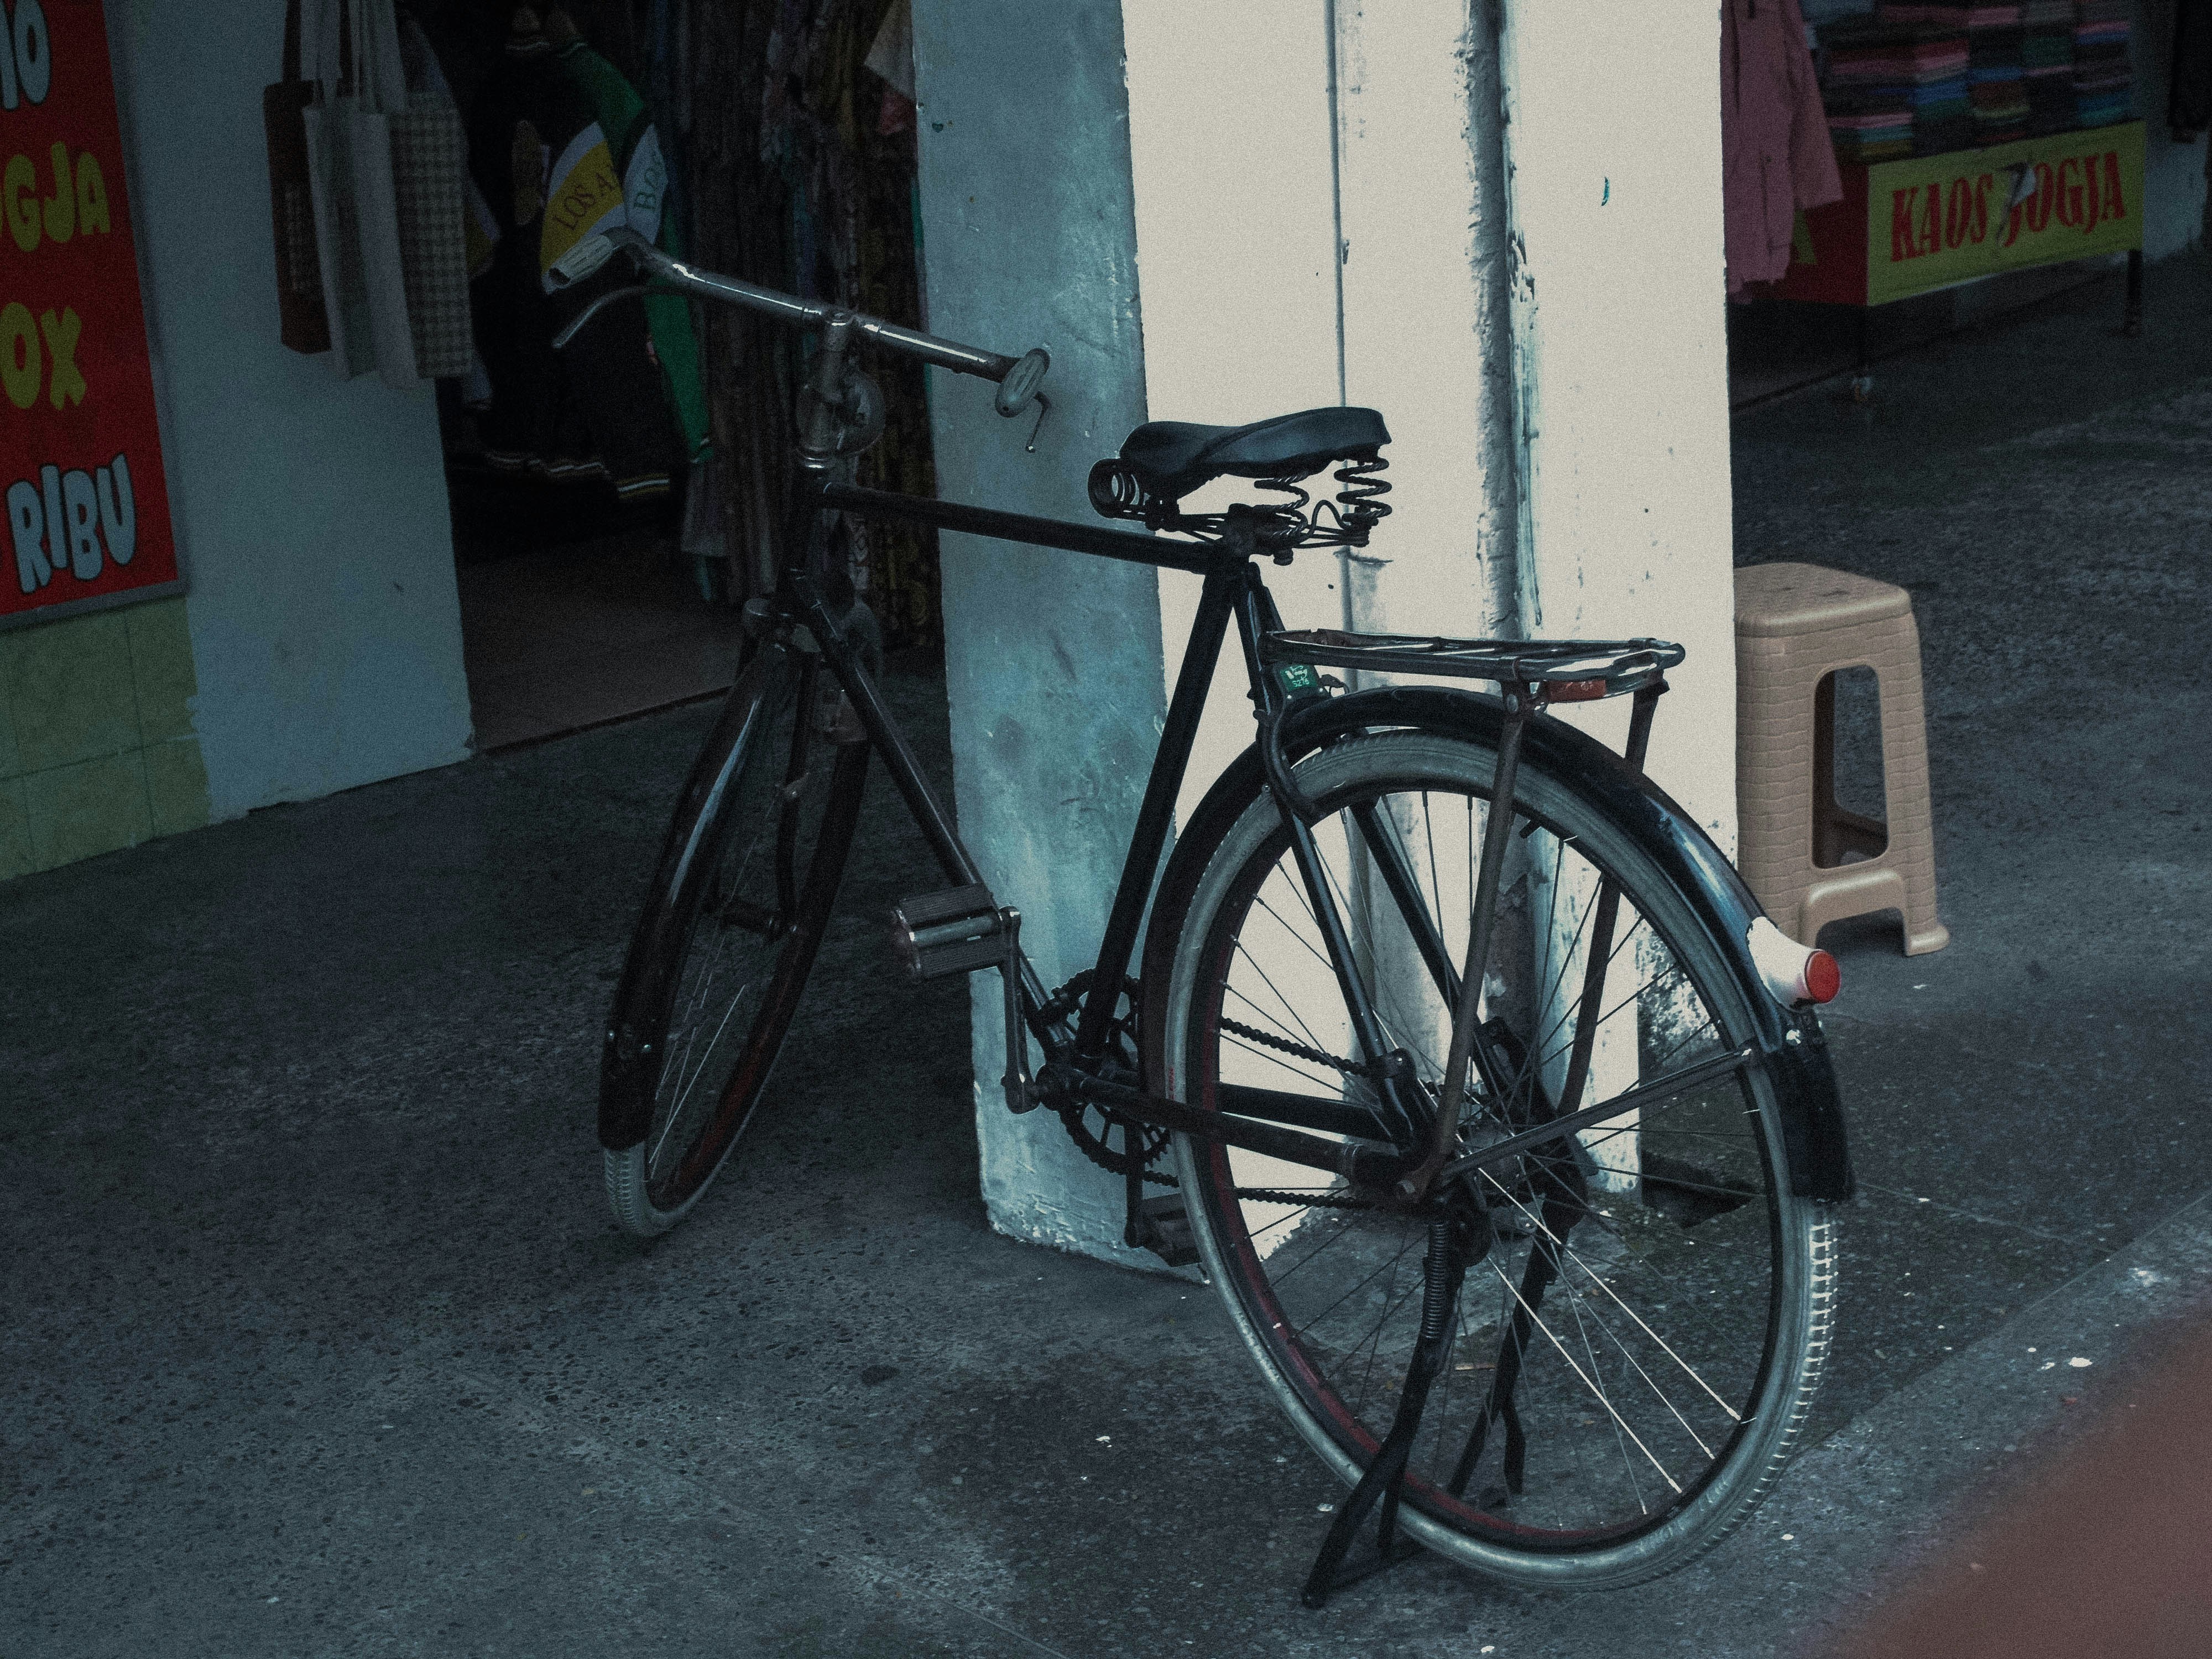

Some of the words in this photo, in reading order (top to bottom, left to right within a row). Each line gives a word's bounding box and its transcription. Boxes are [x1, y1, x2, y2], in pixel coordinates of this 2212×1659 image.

[0, 140, 111, 253] GJA
[553, 184, 596, 231] LOS
[1891, 174, 1993, 262] KAOS
[6, 451, 137, 595] RIBU
